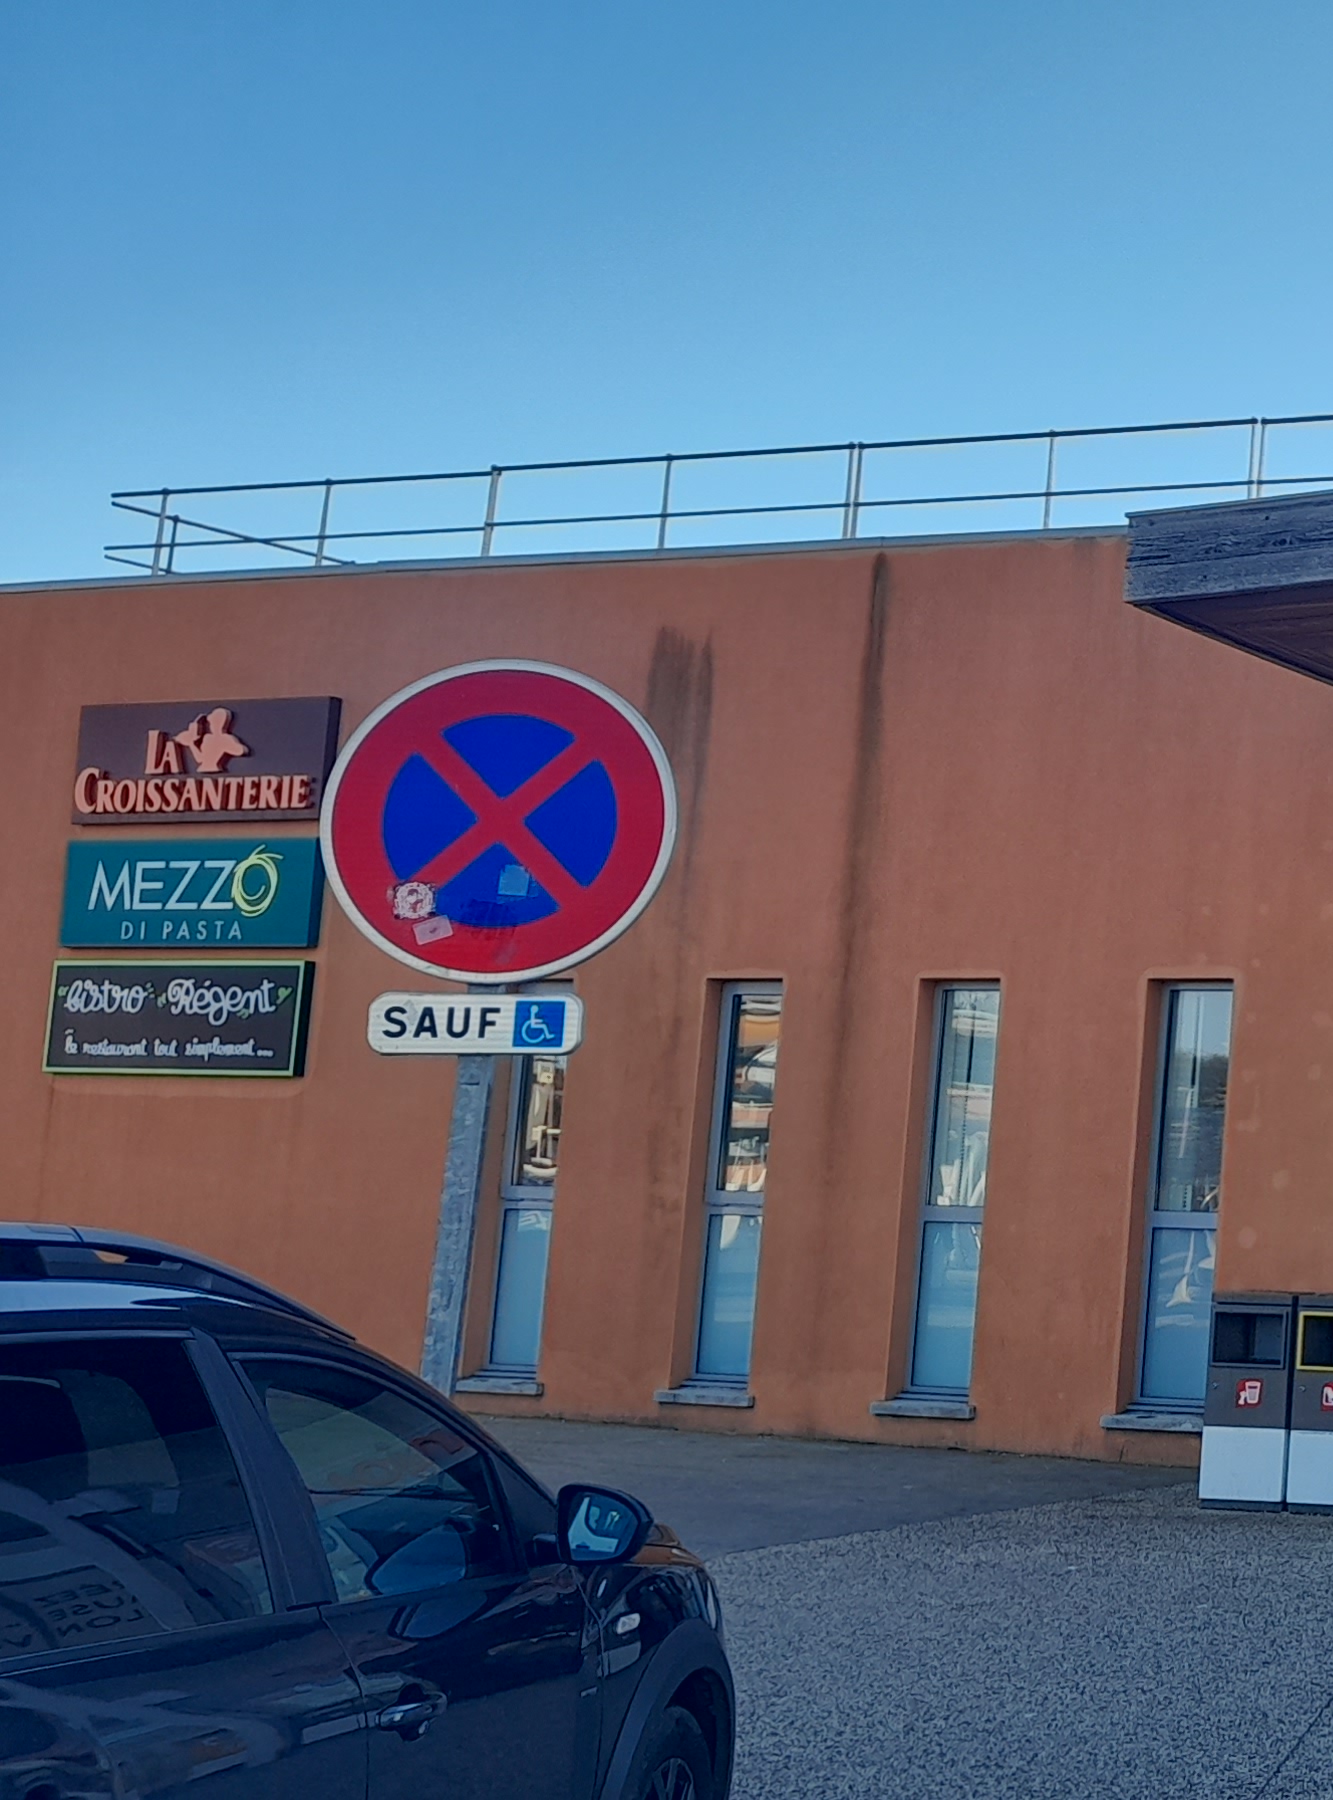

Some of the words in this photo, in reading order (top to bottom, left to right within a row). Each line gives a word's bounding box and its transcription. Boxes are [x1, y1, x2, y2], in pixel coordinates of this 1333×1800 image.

[74, 767, 310, 815] CROISSANTERIE
[88, 844, 283, 917] MEZZO
[120, 920, 146, 940] DI
[162, 920, 242, 940] PASTA
[382, 1006, 501, 1039] SAUF
